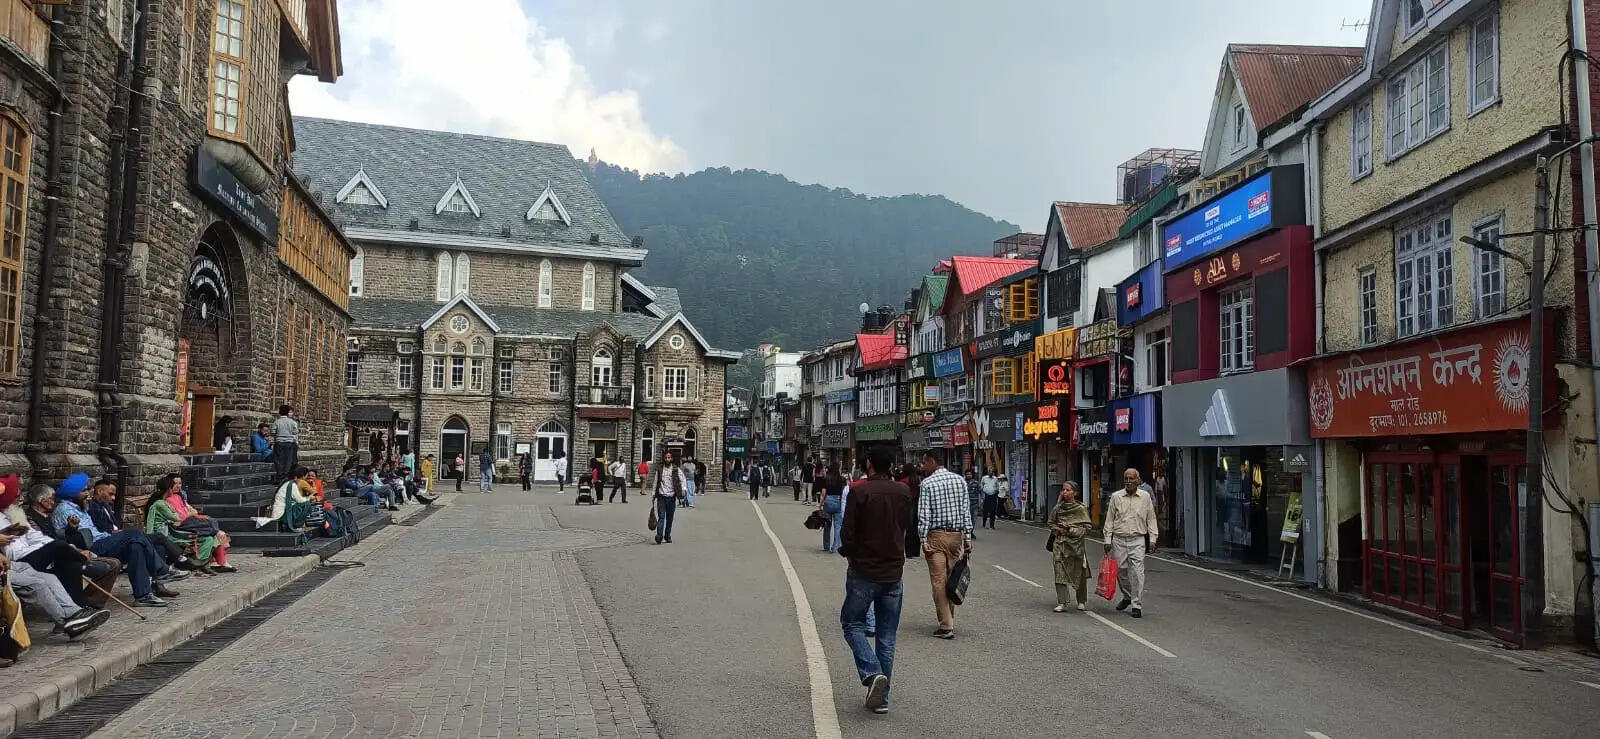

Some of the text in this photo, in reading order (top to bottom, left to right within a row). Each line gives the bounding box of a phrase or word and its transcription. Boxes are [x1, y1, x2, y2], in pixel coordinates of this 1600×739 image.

[1336, 353, 1422, 400] अग्निशमन
[1428, 337, 1484, 387] केन्द्र
[1390, 395, 1420, 412] माल रोड
[1024, 417, 1059, 440] degrees
[1413, 410, 1448, 428] 2658976
